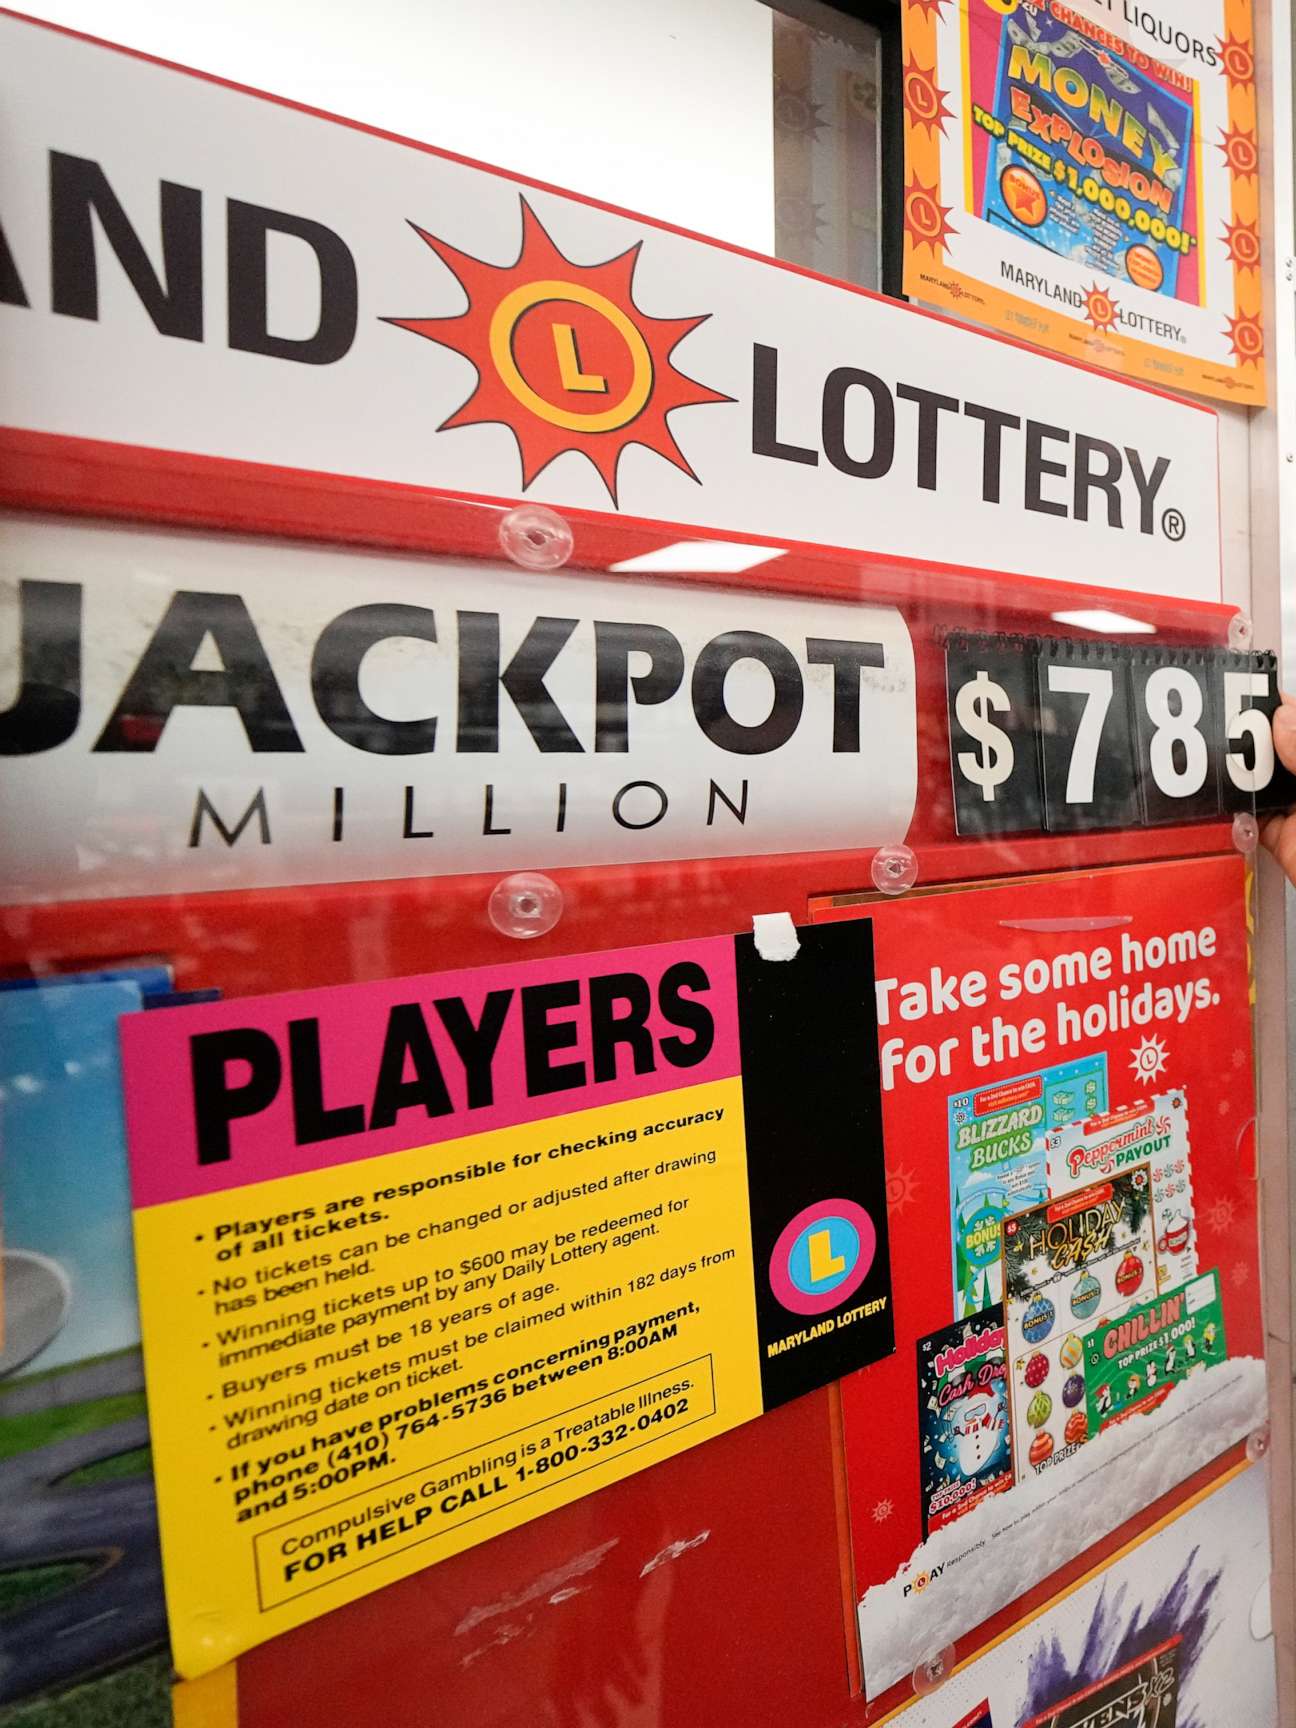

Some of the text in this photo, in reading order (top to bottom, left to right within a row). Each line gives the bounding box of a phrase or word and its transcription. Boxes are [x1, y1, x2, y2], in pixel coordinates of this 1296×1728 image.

[1052, 3, 1125, 56] CHANCES
[1126, 46, 1150, 71] TO
[1123, 0, 1218, 67] LIQUORS
[971, 104, 1006, 138] TOP
[1006, 130, 1054, 177] PRIZE
[1007, 45, 1180, 178] MONEY
[1010, 86, 1174, 214] EXPLOSION
[1000, 260, 1083, 308] MARYLAND
[0, 580, 884, 757] JACKPOT
[189, 778, 750, 848] MILLION
[875, 926, 1217, 1026] Take some home
[190, 960, 717, 1166] PLAYERS
[881, 977, 1221, 1091] for the holidays.
[957, 1104, 1043, 1149] BLIZZARD
[970, 1132, 1032, 1169] BUCKS
[1067, 1116, 1154, 1177] Peppermint
[1116, 1135, 1171, 1167] PAYOUT
[214, 1107, 725, 1242] Players are responsible for checking accuracy
[212, 1150, 717, 1296] No tickets can be changed or adjusted after drawing
[216, 1210, 389, 1262] of all tickets.
[1030, 1197, 1126, 1260] HOLIDAY
[215, 1260, 375, 1316] has been held.
[216, 1197, 690, 1347] Winning tickets up to $600 may be redeemed for
[218, 1222, 660, 1368] immediate payment by any Daily Lottery agent.
[221, 1283, 560, 1400] Buyers must be 18 years of age.
[223, 1248, 736, 1429] Winning tickets must be claimed within 182 days from
[767, 1296, 888, 1358] MARYLAND LOTTERY
[935, 1327, 1006, 1378] Holida
[1103, 1292, 1185, 1359] CHILLIN'
[1117, 1354, 1135, 1369] TOP
[1136, 1341, 1158, 1360] PRIZE
[226, 1358, 463, 1450] drawing date on ticket.
[231, 1300, 700, 1481] If you have problems concerning payment,
[233, 1323, 678, 1505] phone (410) 764-5736 between 8:00AM
[939, 1372, 974, 1406] Cash
[236, 1450, 397, 1523] and 5:00PM.
[281, 1379, 694, 1556] Compulsive Gambling is a Treatable Illness.
[284, 1398, 689, 1582] FOR HELP CALL 1-800-332-0402
